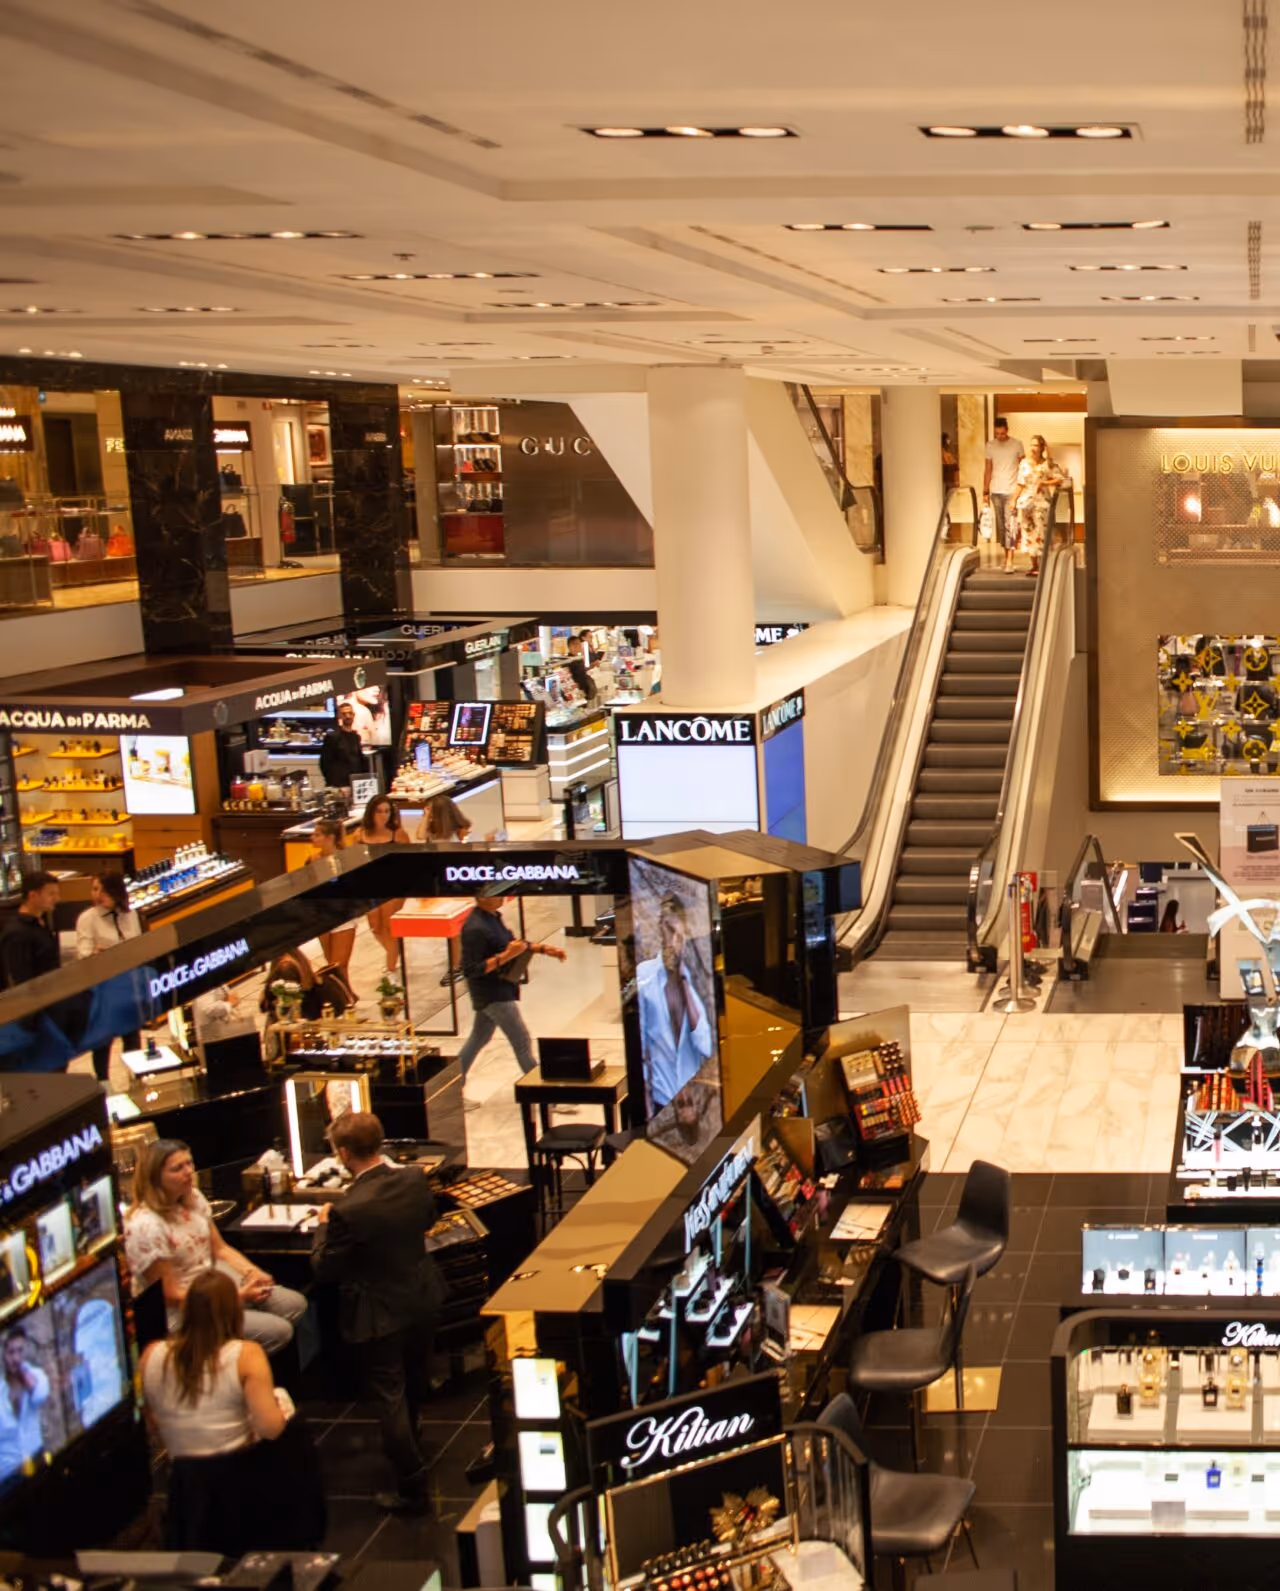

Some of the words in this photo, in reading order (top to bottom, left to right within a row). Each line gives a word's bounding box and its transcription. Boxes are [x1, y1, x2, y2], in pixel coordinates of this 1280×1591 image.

[1160, 454, 1235, 474] LOUIS
[0, 710, 66, 728] ACQUA
[82, 712, 152, 729] PARMA
[620, 716, 751, 742] LANCÔME
[621, 1406, 754, 1470] Kilian
